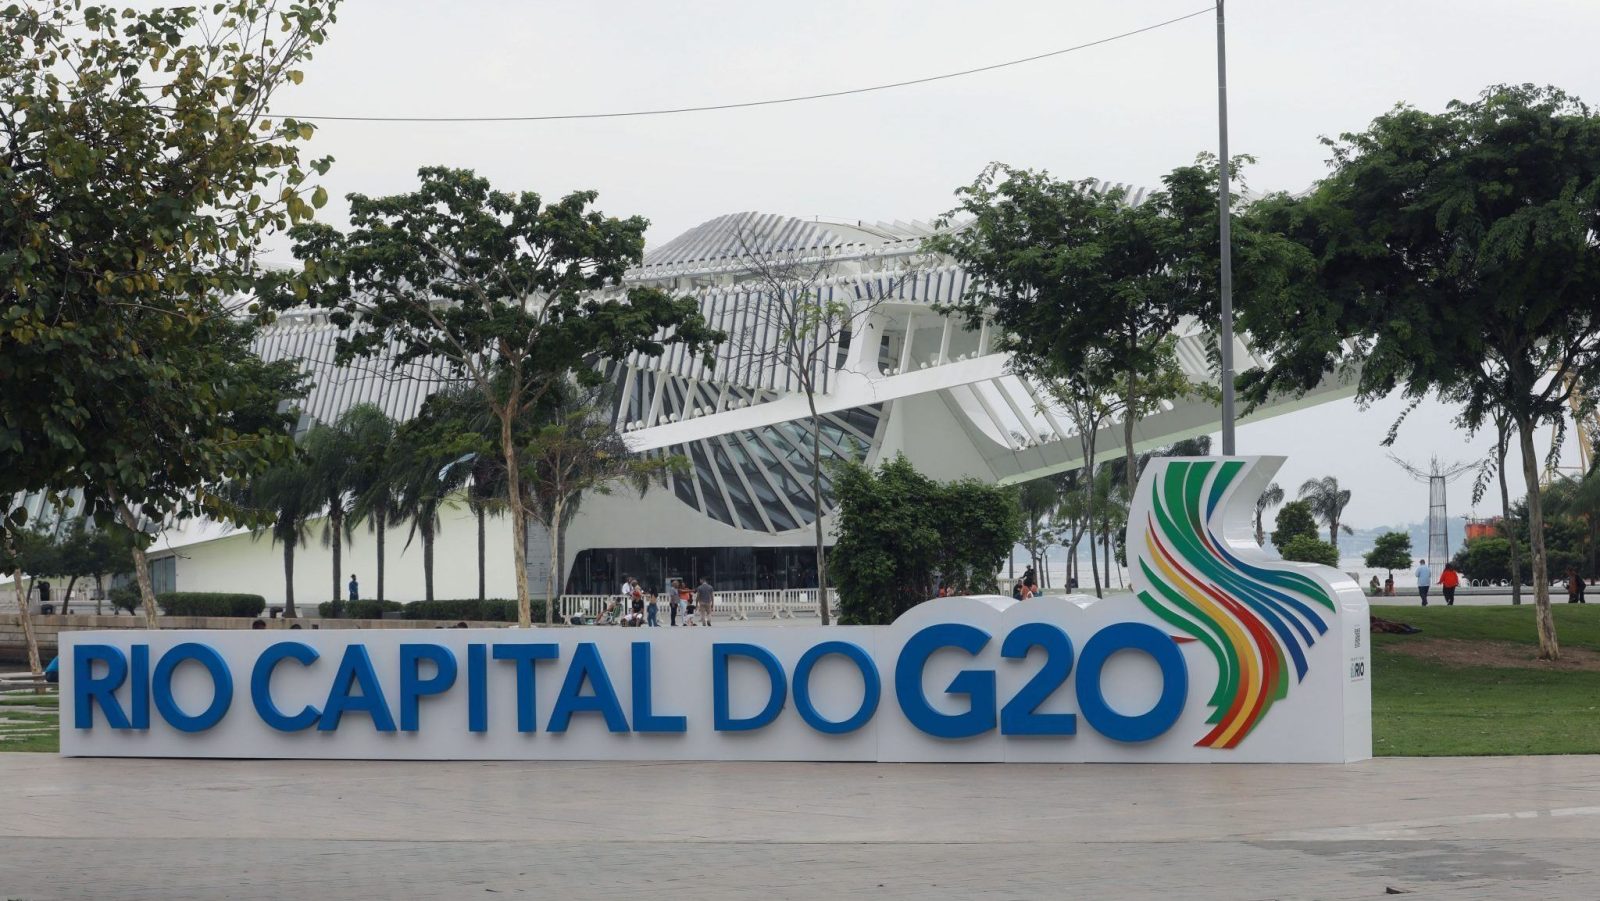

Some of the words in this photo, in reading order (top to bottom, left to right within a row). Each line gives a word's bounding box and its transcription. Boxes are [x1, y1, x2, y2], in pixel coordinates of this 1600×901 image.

[73, 642, 233, 733] RIO
[251, 641, 687, 733] CAPITAL
[712, 641, 881, 734] DO
[894, 622, 1188, 743] G20
